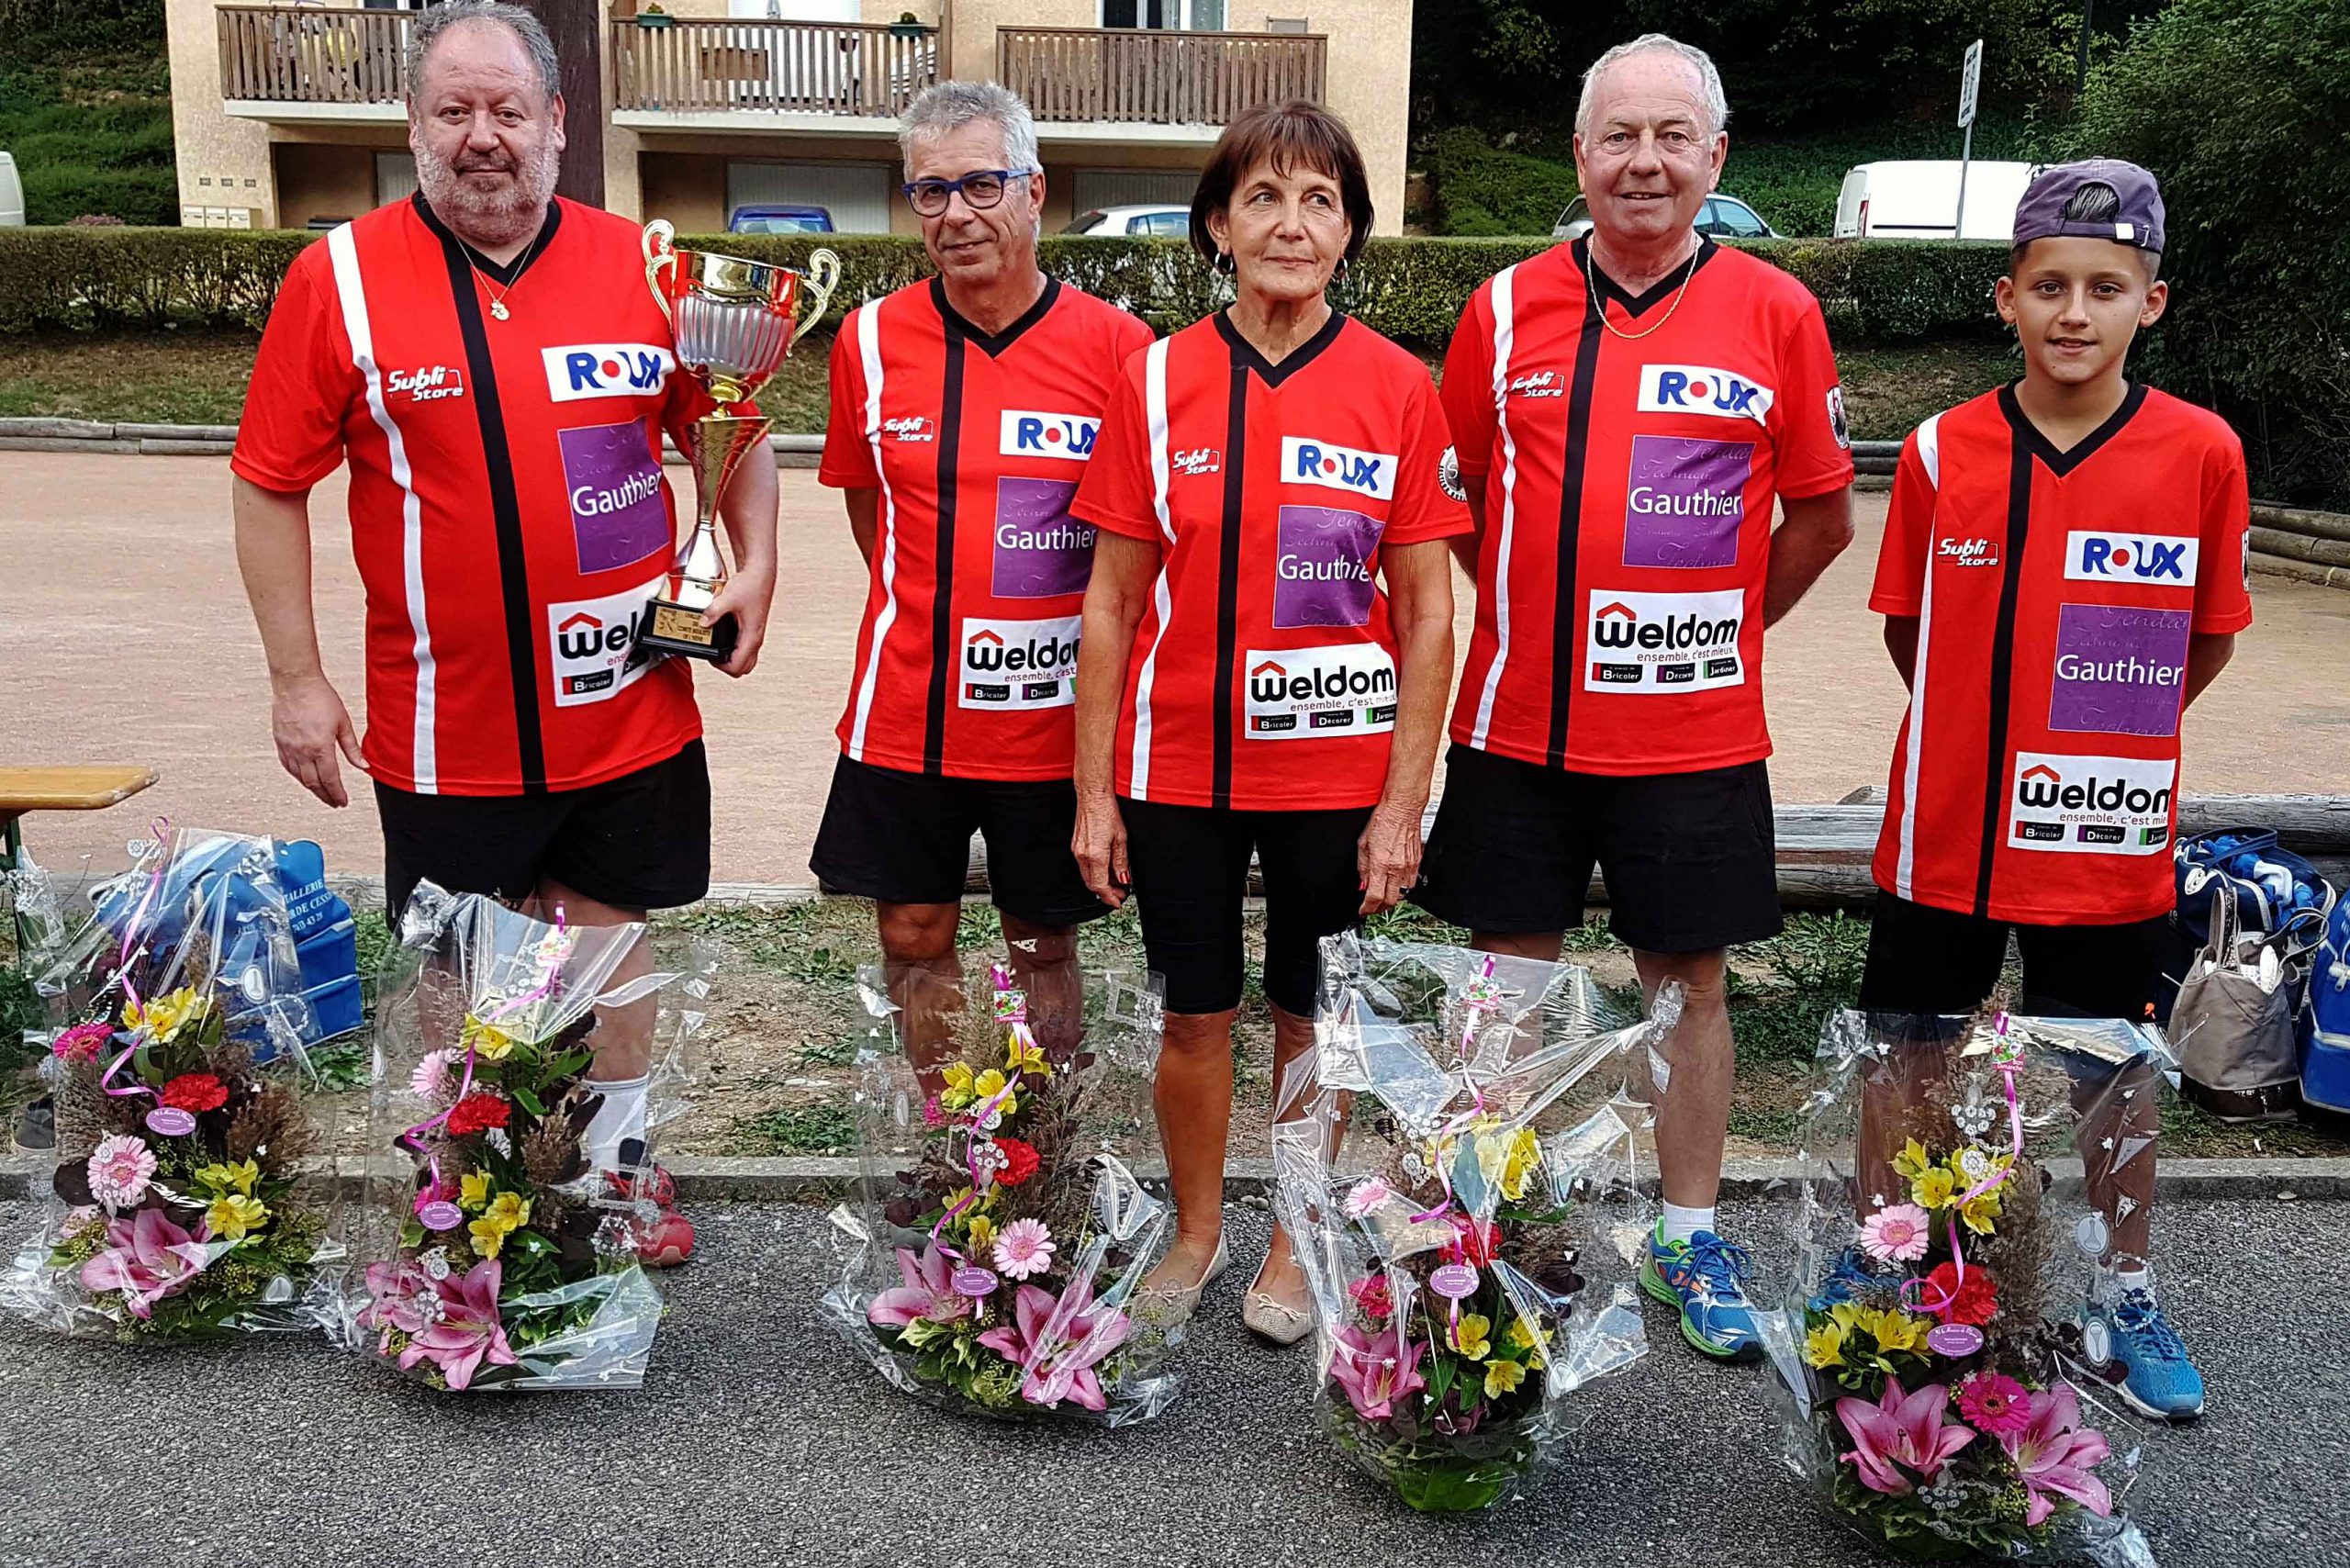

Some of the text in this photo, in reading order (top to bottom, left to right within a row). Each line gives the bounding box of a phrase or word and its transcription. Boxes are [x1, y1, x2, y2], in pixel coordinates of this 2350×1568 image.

[386, 365, 446, 393] Subli
[565, 351, 662, 392] ROUX
[1508, 370, 1555, 392] Subli
[410, 386, 464, 402] Store
[1523, 386, 1563, 398] Store
[1657, 371, 1759, 418] ROUX
[882, 416, 925, 433] Subli
[897, 431, 934, 442] Store
[1171, 447, 1211, 469] Subli
[1184, 464, 1220, 476] Store
[1297, 444, 1381, 492] ROUX
[572, 470, 663, 518] Gauthier
[1628, 486, 1741, 516] Gauthier
[996, 523, 1097, 551] Gauthier
[1937, 538, 1988, 555] Subli
[1956, 554, 1998, 566] Store
[2082, 538, 2187, 579] ROUX
[1278, 554, 1371, 583] Gauthie
[558, 610, 639, 660] wel
[1637, 645, 1734, 662] ensemble, c'est mieux
[1004, 670, 1055, 682] ensemble,
[1603, 671, 1639, 680] Bricoler
[2055, 654, 2185, 687] Gauthier
[574, 678, 611, 692] Bricoler
[975, 689, 1007, 699] Bricoler
[1290, 699, 1346, 712] ensemble,
[1348, 697, 1374, 708] c'est
[1260, 721, 1294, 730] Bricoler
[2059, 812, 2167, 826] ensemble, c'est mie
[2025, 828, 2063, 839] Bricoler
